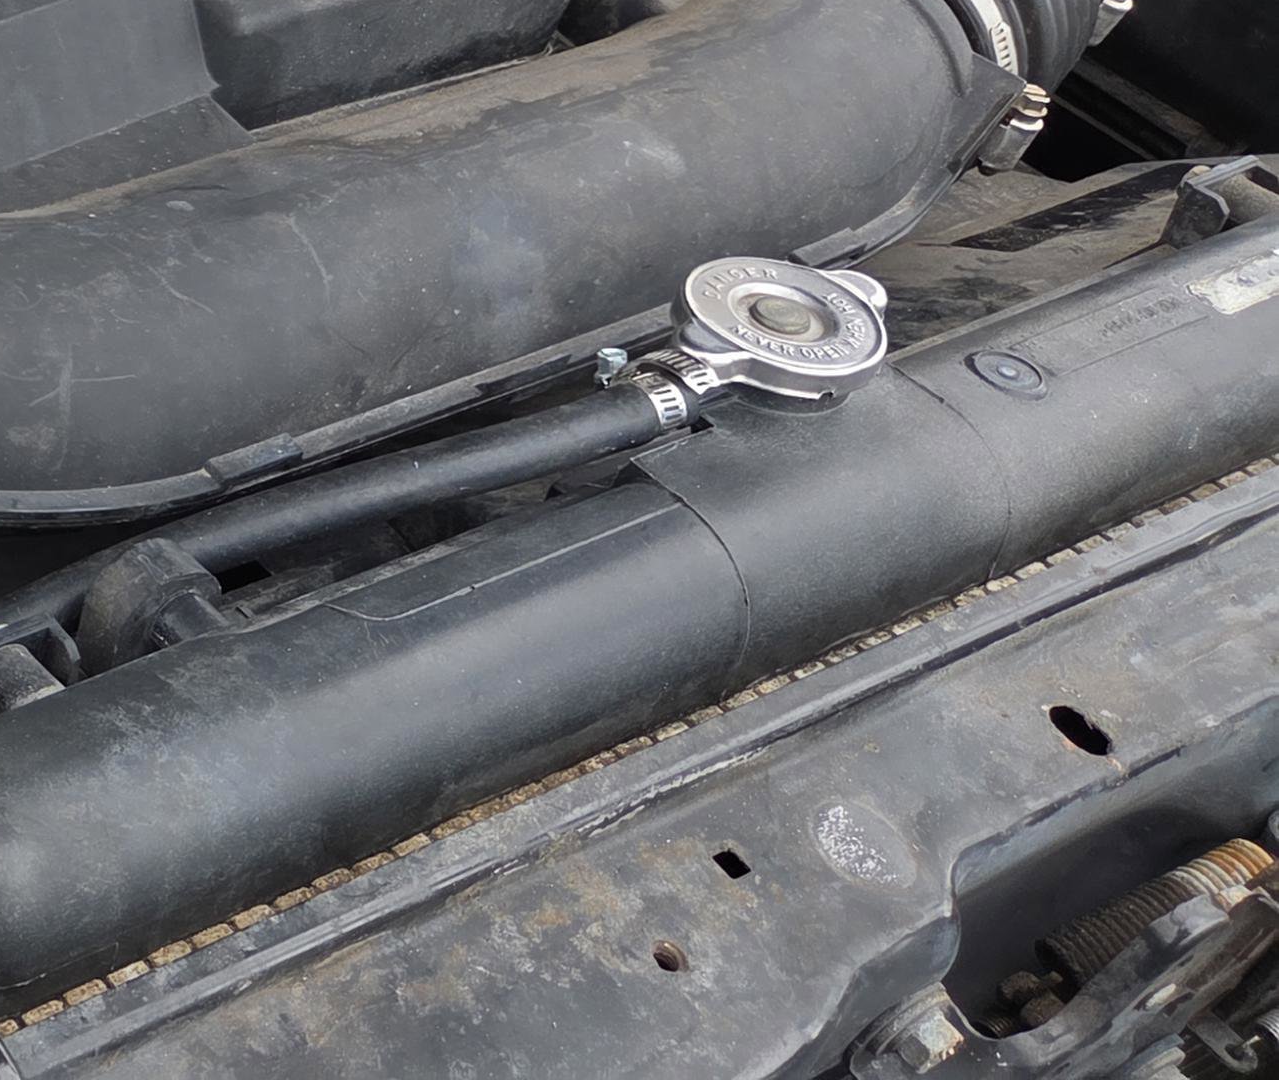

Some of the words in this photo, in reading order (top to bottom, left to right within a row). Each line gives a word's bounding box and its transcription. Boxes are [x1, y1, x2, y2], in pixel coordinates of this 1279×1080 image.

[702, 266, 778, 298] DANGER
[733, 324, 796, 355] NEVER
[801, 344, 849, 359] OPEN
